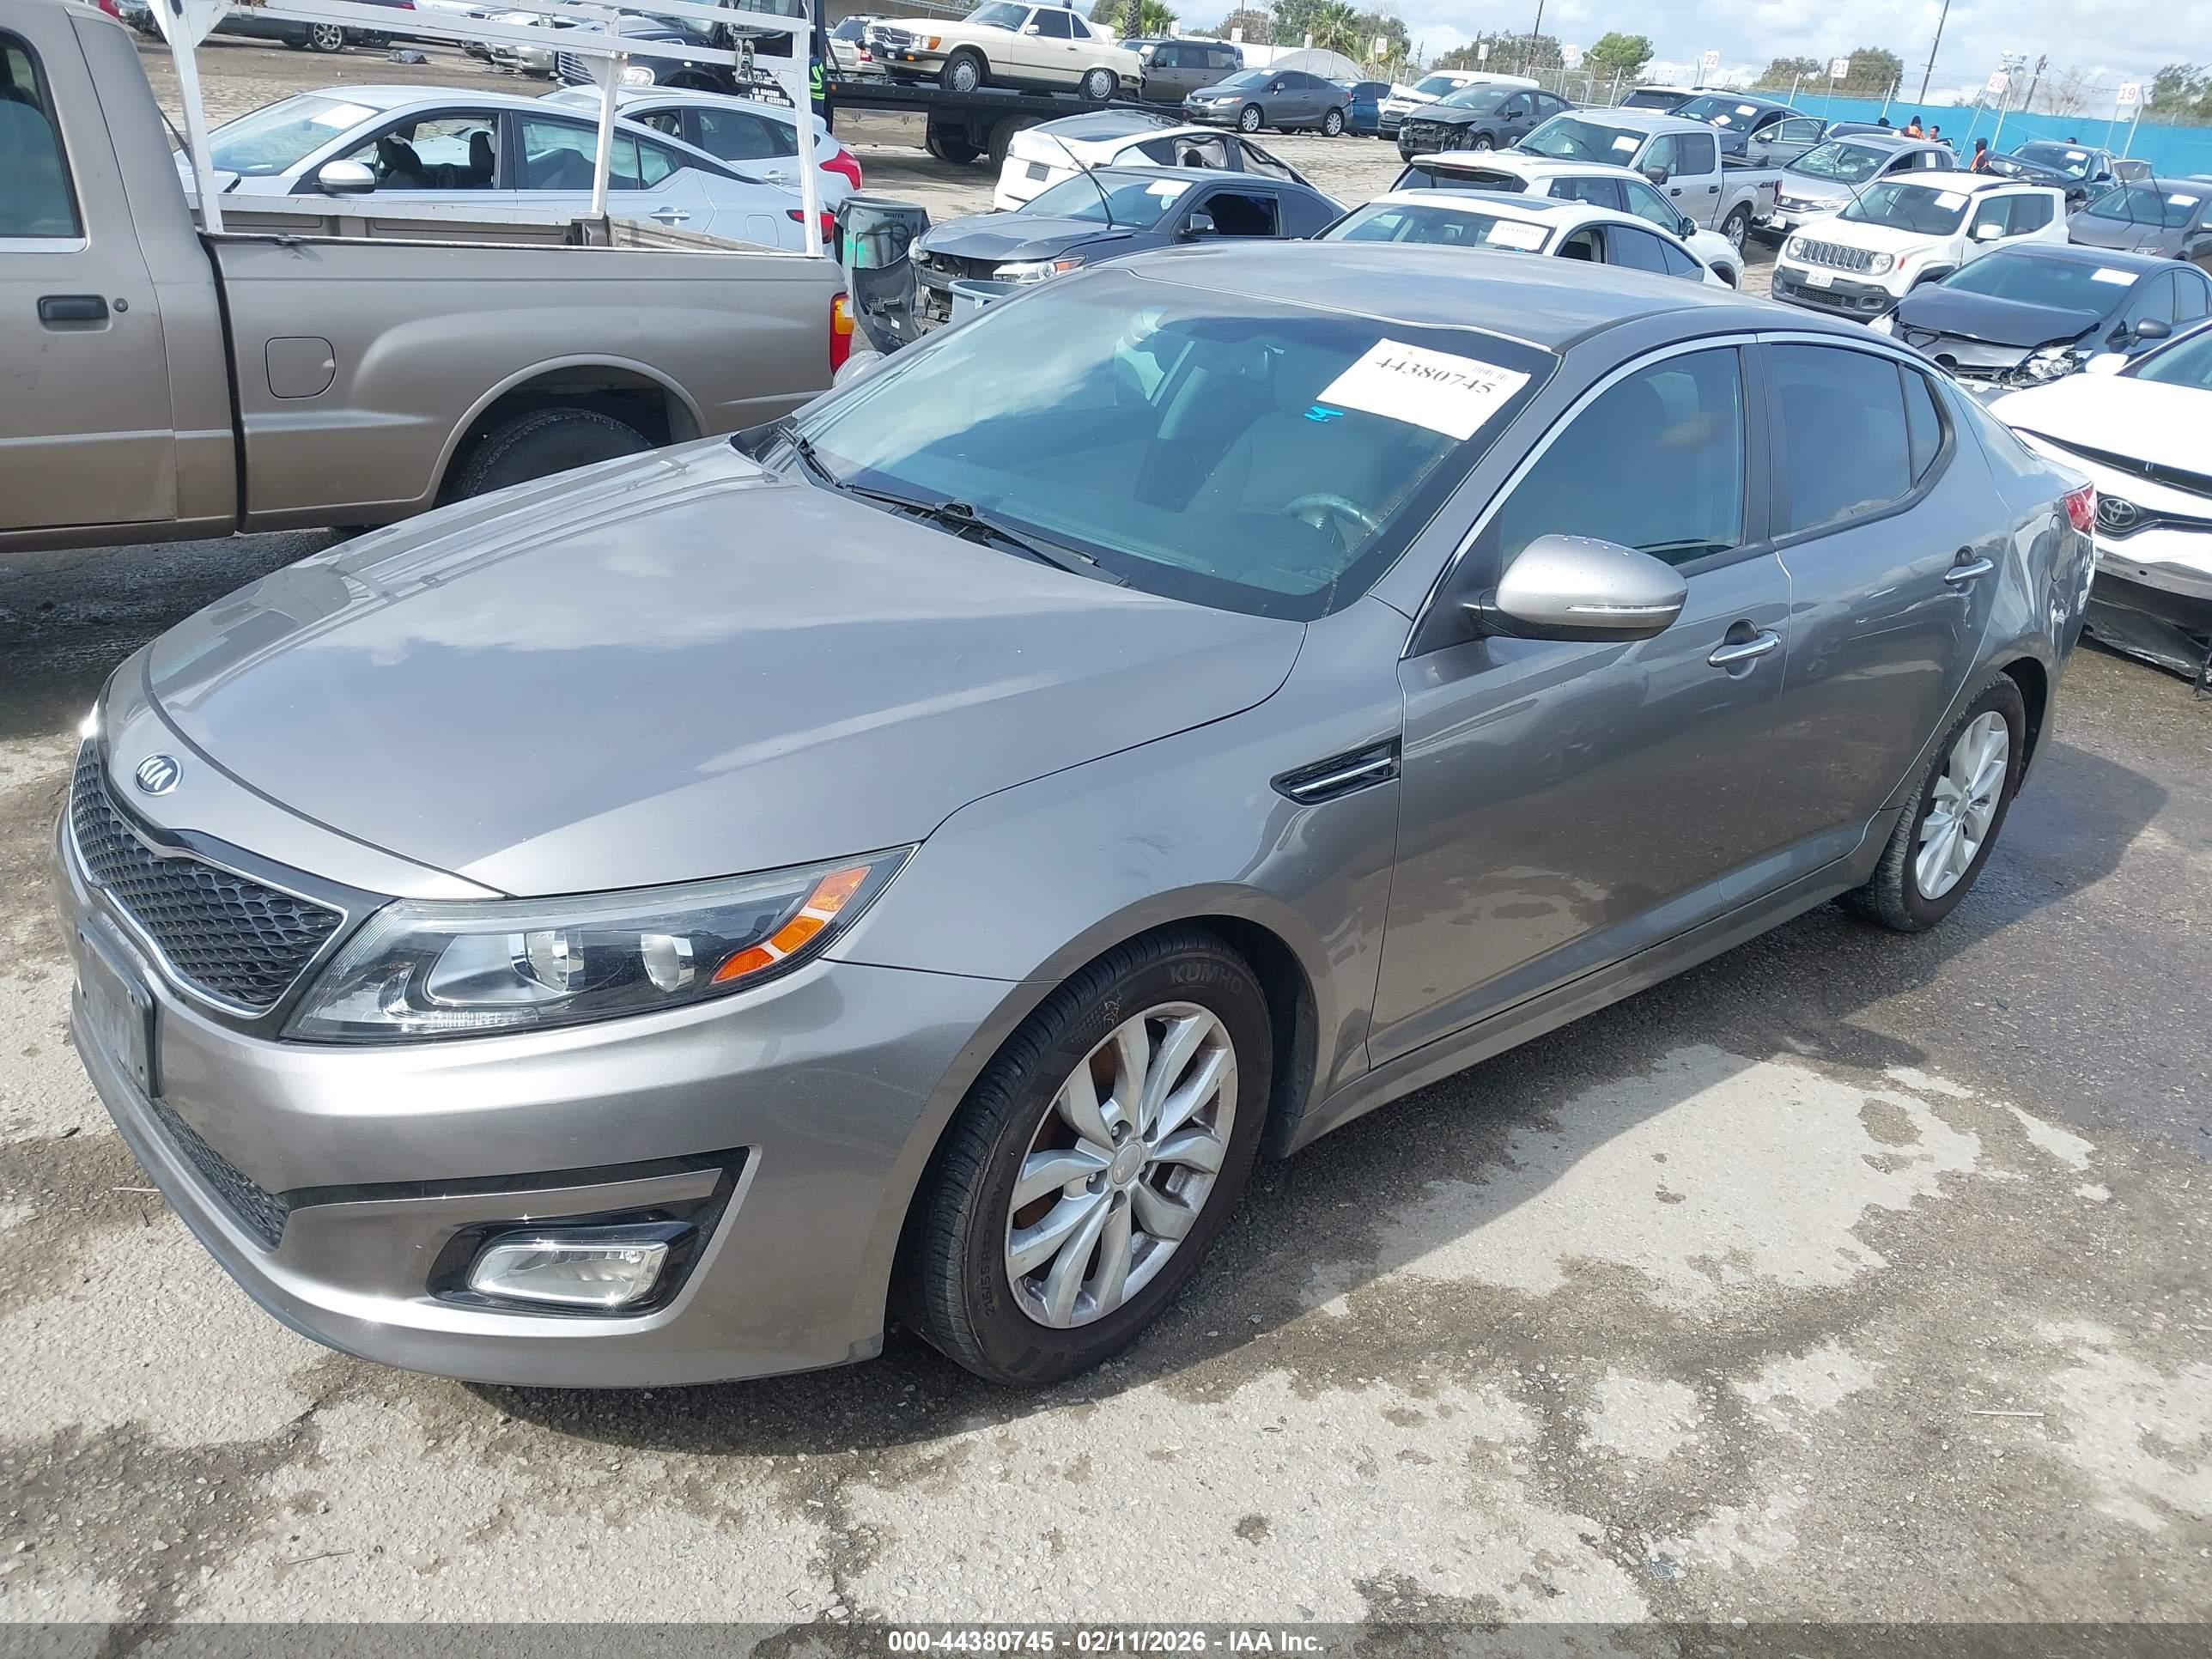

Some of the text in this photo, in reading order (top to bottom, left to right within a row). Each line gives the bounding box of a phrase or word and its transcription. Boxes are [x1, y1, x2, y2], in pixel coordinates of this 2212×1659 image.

[1376, 41, 1387, 50] 25
[1705, 54, 1717, 65] 22
[1833, 64, 1845, 75] 21
[1990, 76, 2006, 89] 20
[2119, 88, 2136, 100] 19
[1376, 357, 1497, 394] 44380745
[137, 756, 173, 791] KIA
[1169, 962, 1244, 994] KUMHO
